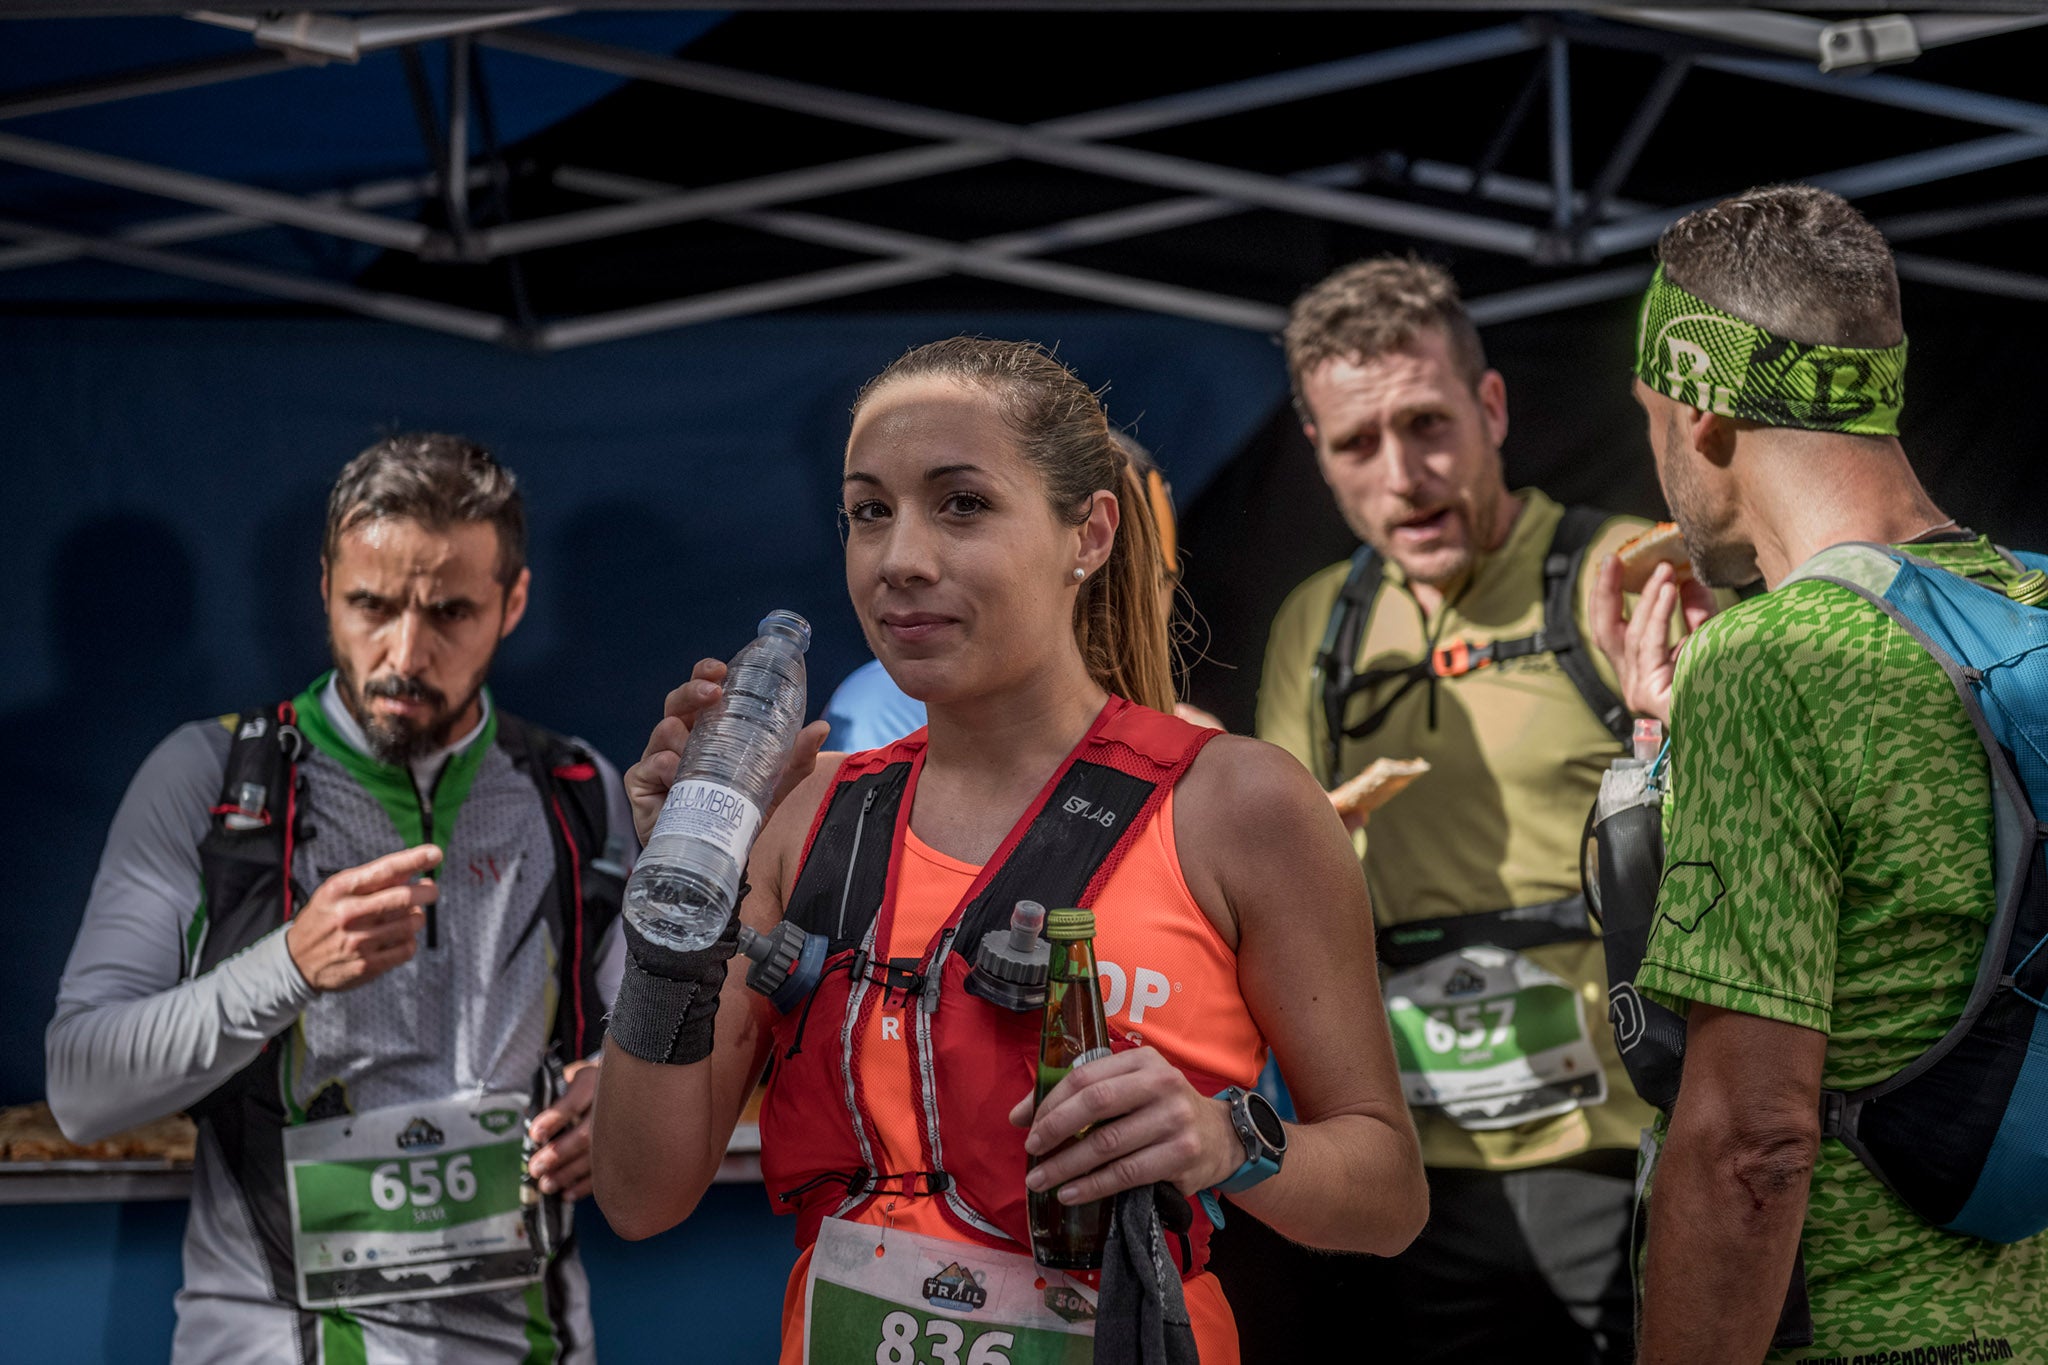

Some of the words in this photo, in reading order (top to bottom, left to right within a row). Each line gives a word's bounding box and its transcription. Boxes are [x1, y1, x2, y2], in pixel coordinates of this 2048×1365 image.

[667, 784, 745, 827] ÑAUMBRÍA
[1096, 961, 1171, 1024] OP
[1424, 999, 1516, 1054] 657
[370, 1155, 478, 1212] 656
[876, 1310, 1016, 1365] 836
[1796, 1329, 2014, 1365] eenpowerst.com
